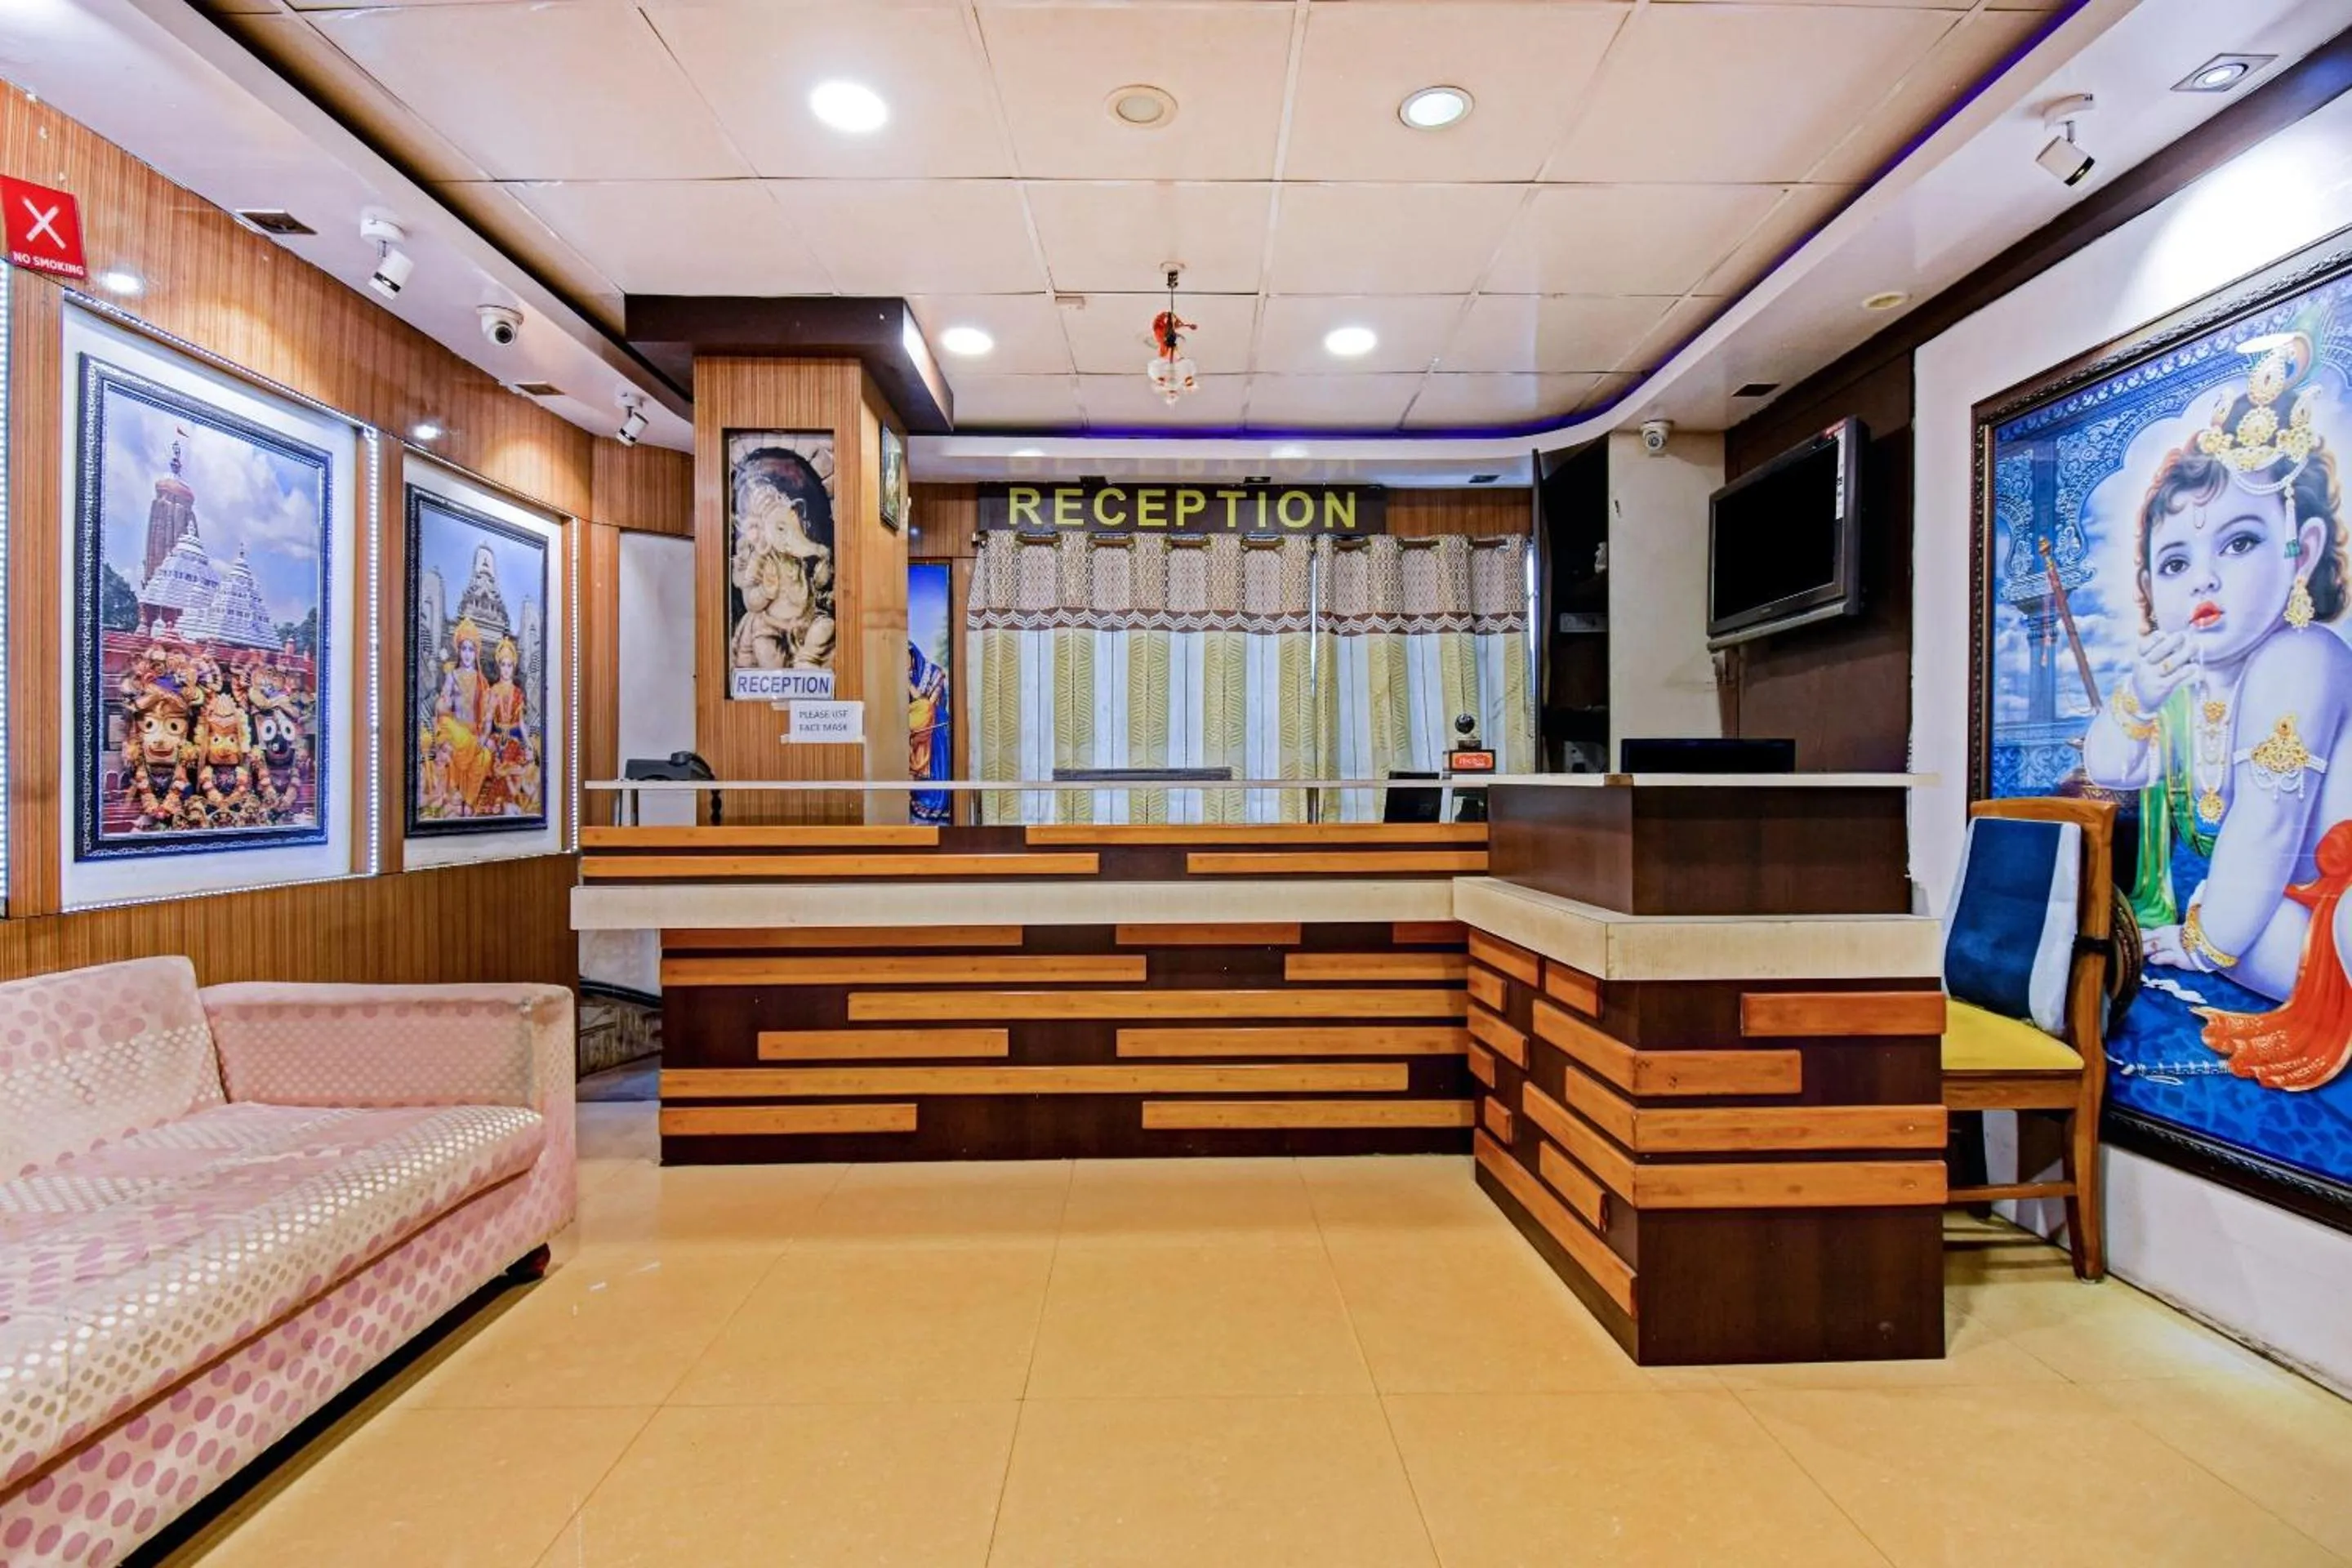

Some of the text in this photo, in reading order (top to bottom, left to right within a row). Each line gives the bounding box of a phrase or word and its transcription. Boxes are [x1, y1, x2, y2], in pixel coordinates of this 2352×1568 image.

[12, 251, 84, 276] NO SMOKING
[1009, 488, 1356, 528] RECEPTION
[737, 676, 830, 693] RECEPTION
[799, 709, 849, 719] PLEASE USE
[799, 724, 848, 732] FACE MASK
